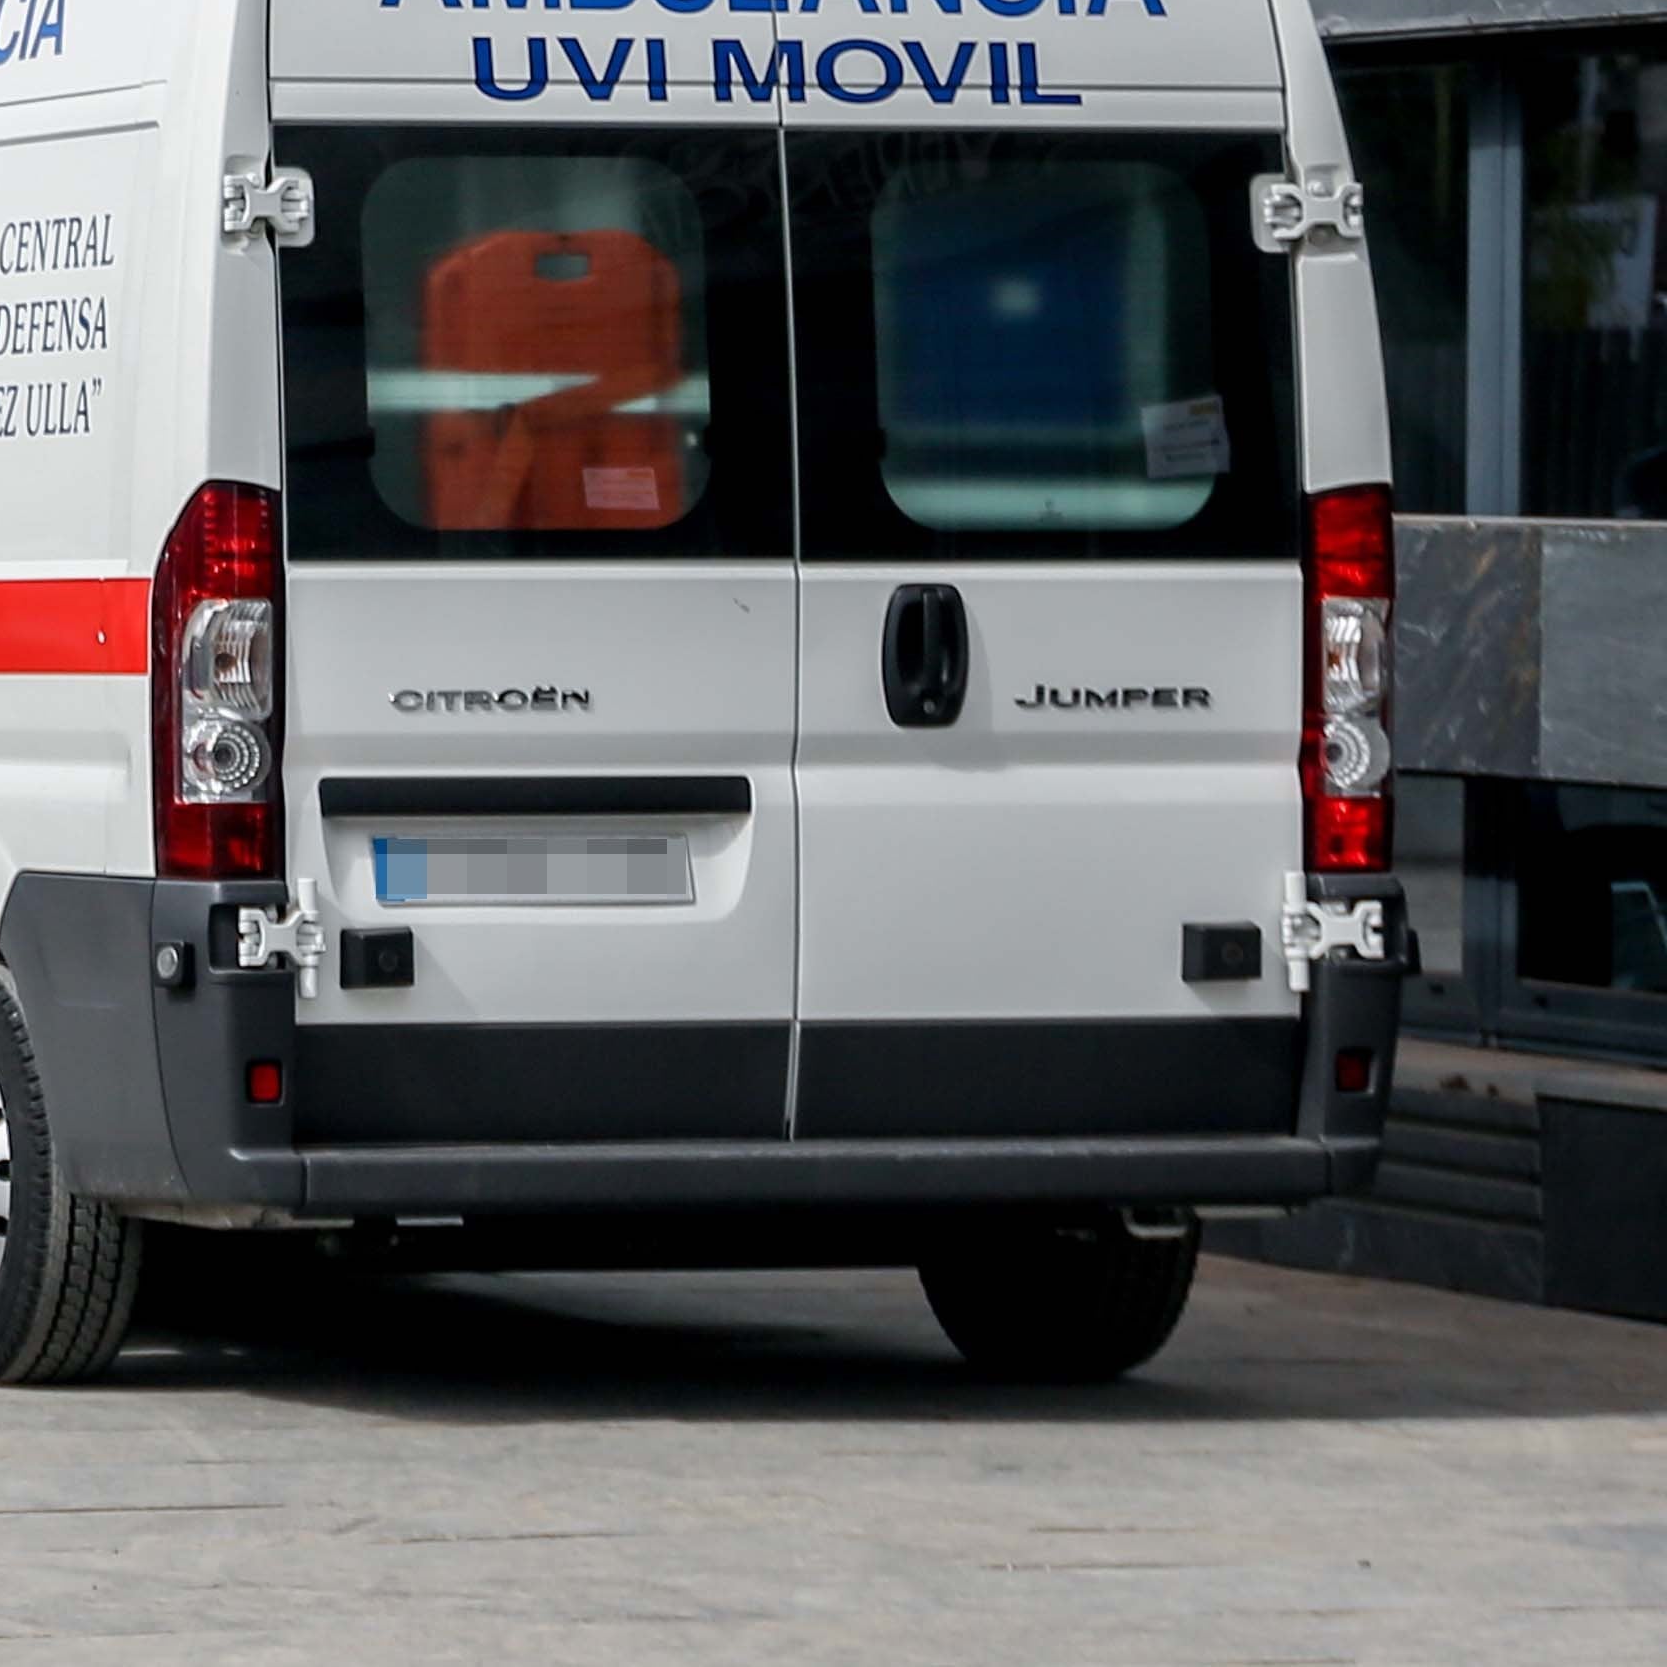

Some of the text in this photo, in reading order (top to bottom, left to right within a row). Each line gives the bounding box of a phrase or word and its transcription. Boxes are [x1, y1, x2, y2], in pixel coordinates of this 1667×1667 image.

[472, 36, 1083, 106] UVI MOVIL
[25, 377, 102, 436] ULLA”
[390, 684, 1212, 712] CITROËN JUMPER
